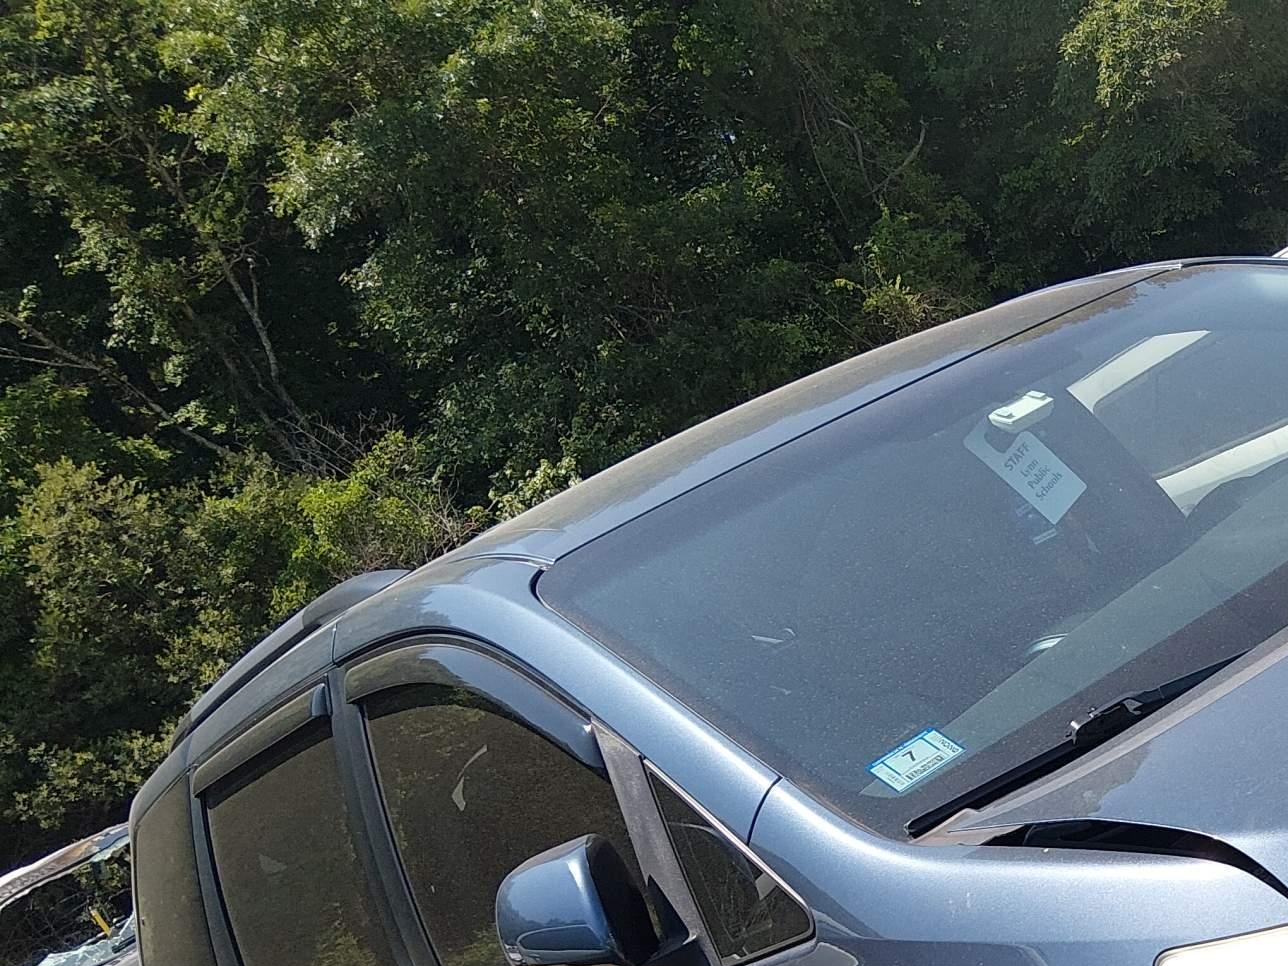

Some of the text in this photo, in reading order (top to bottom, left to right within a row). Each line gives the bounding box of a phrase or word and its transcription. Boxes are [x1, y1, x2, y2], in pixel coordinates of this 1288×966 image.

[1004, 442, 1031, 471] STAFF
[1020, 459, 1040, 478] Lynn
[1027, 464, 1051, 490] Public
[1035, 471, 1063, 500] Schools
[902, 750, 916, 762] 7
